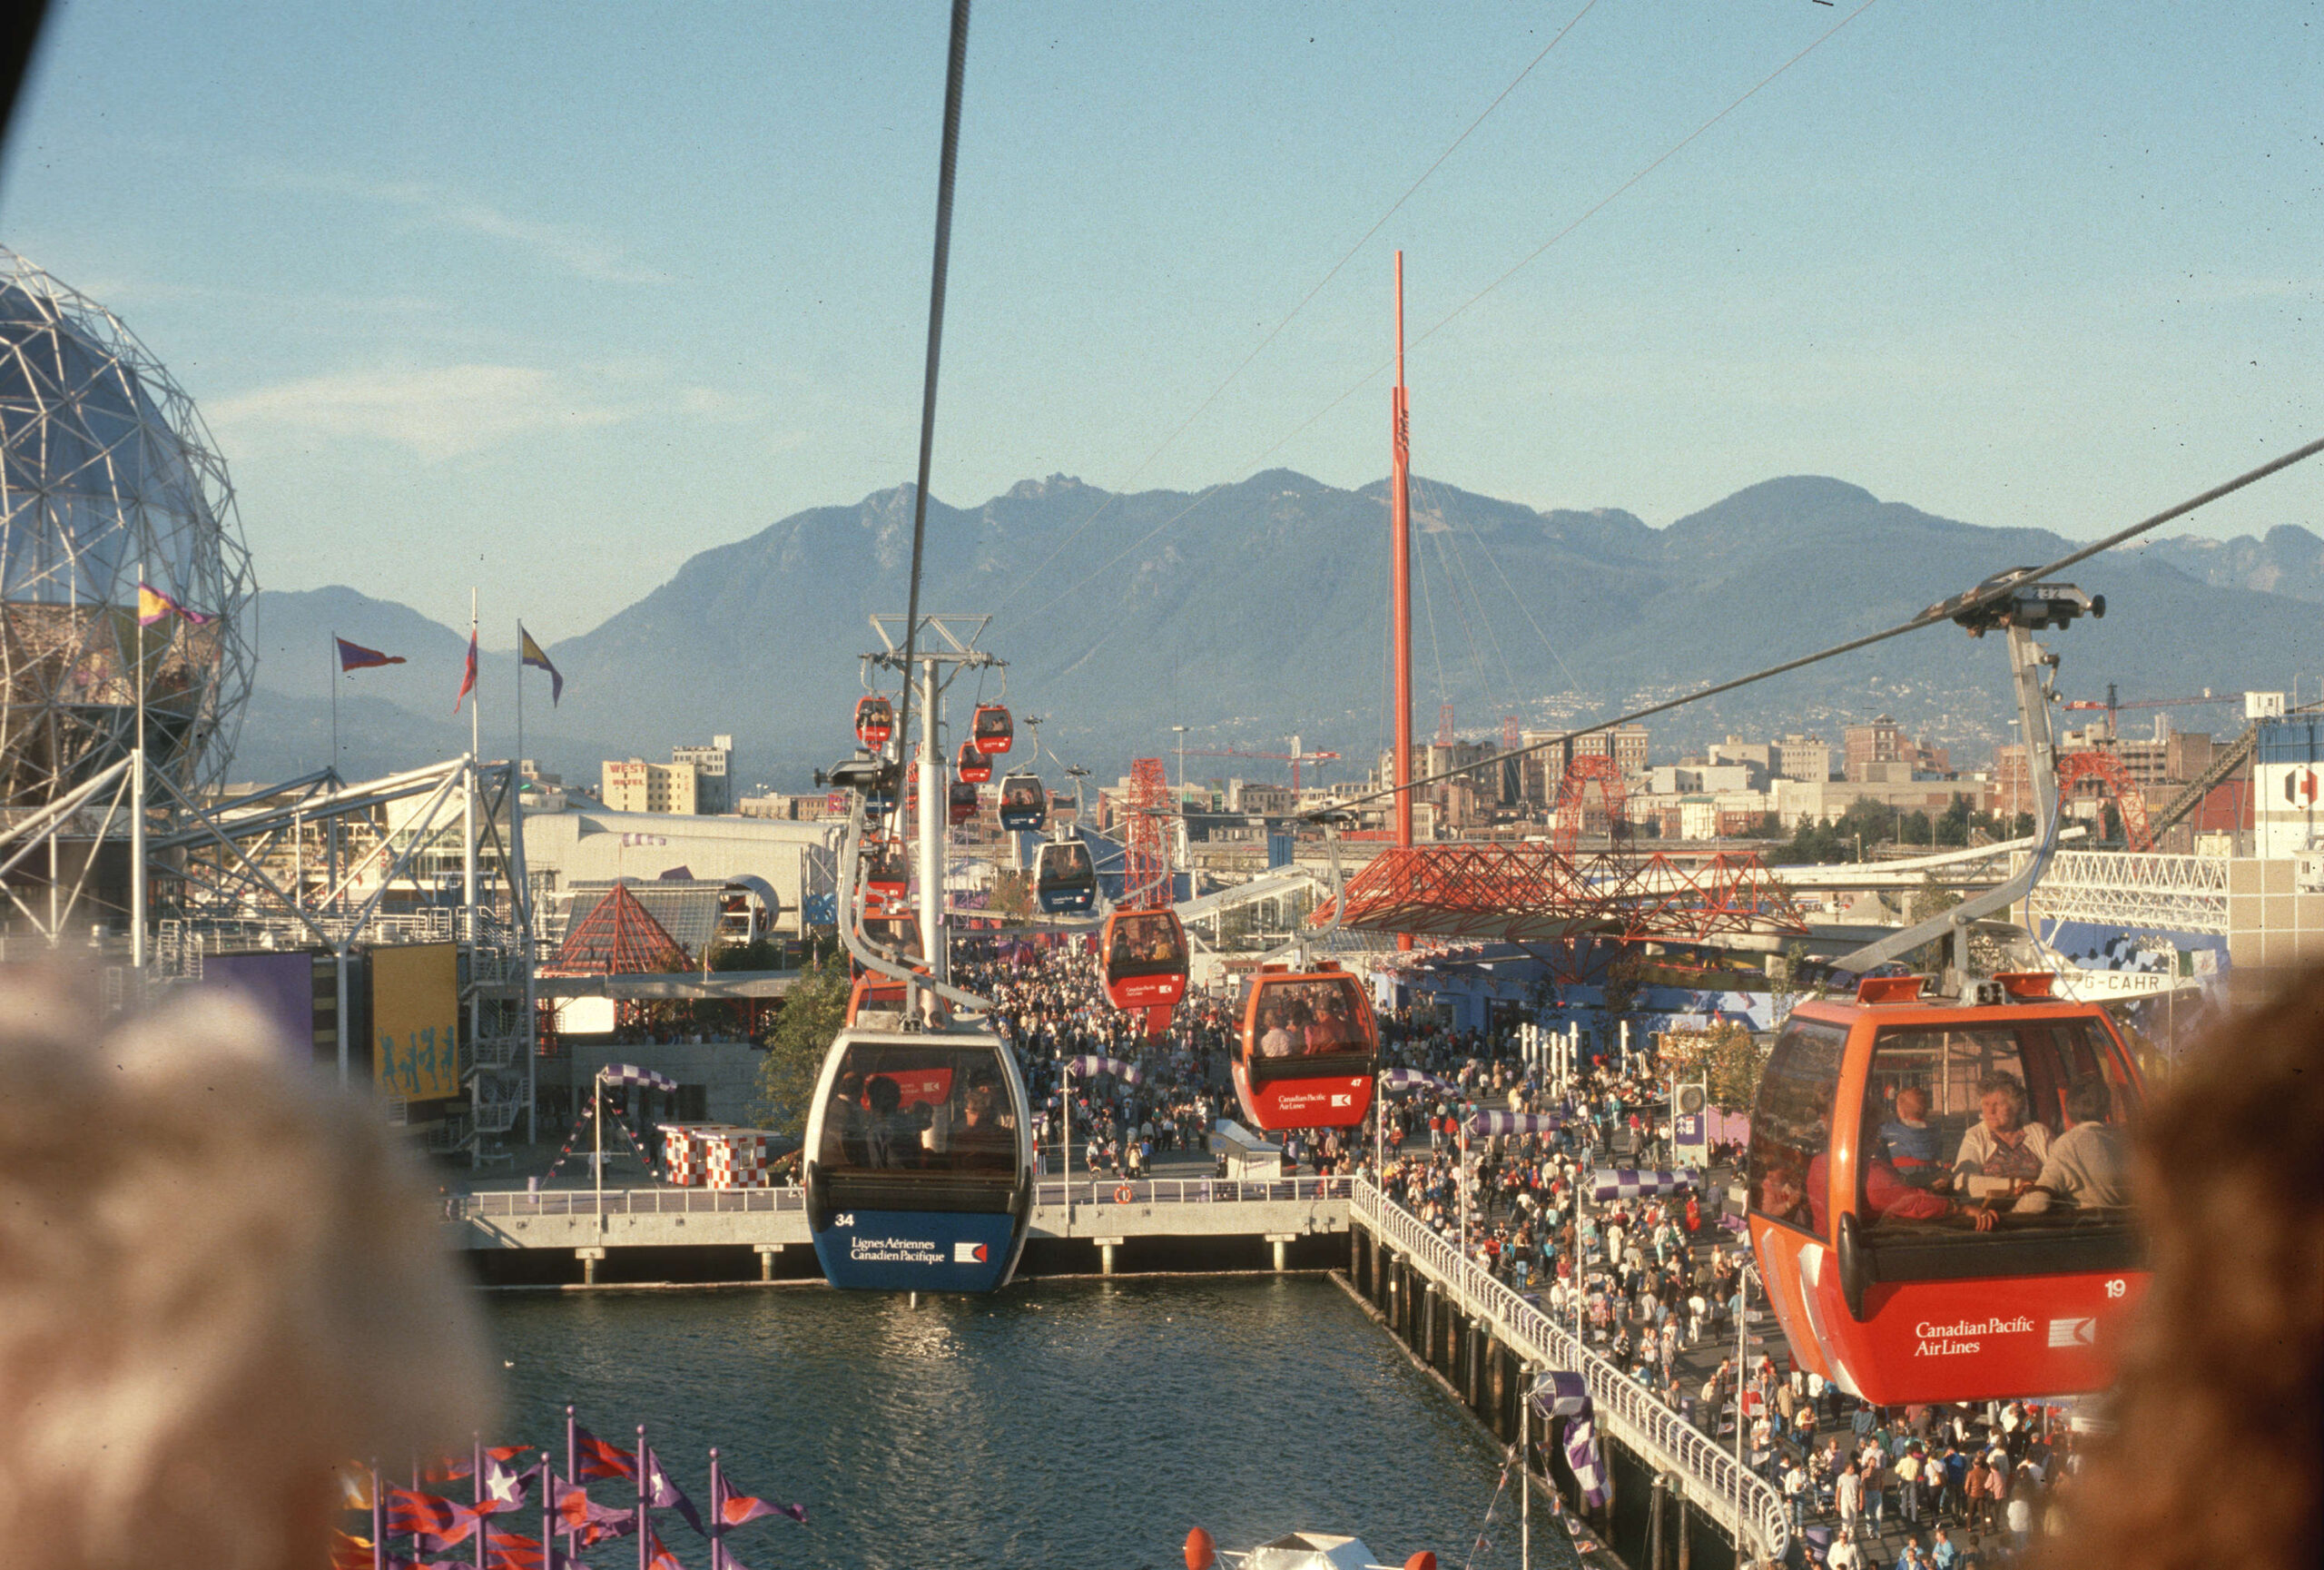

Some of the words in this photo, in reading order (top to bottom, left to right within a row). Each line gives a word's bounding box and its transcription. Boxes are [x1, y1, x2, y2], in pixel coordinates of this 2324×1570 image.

[609, 764, 645, 774] WEST
[2084, 975, 2160, 990] G-CAHR
[1350, 1078, 1362, 1087] 47
[1278, 1094, 1307, 1103] Canadian
[1307, 1092, 1326, 1101] Pacific
[834, 1213, 855, 1227] 34
[851, 1236, 885, 1252] Lignes
[884, 1237, 935, 1250] Aériennes
[850, 1249, 900, 1261] Canadien
[900, 1250, 945, 1265] Pacifique
[2104, 1279, 2127, 1298] 19
[1915, 1319, 1987, 1338] Canadian
[1988, 1315, 2035, 1334] Pacific
